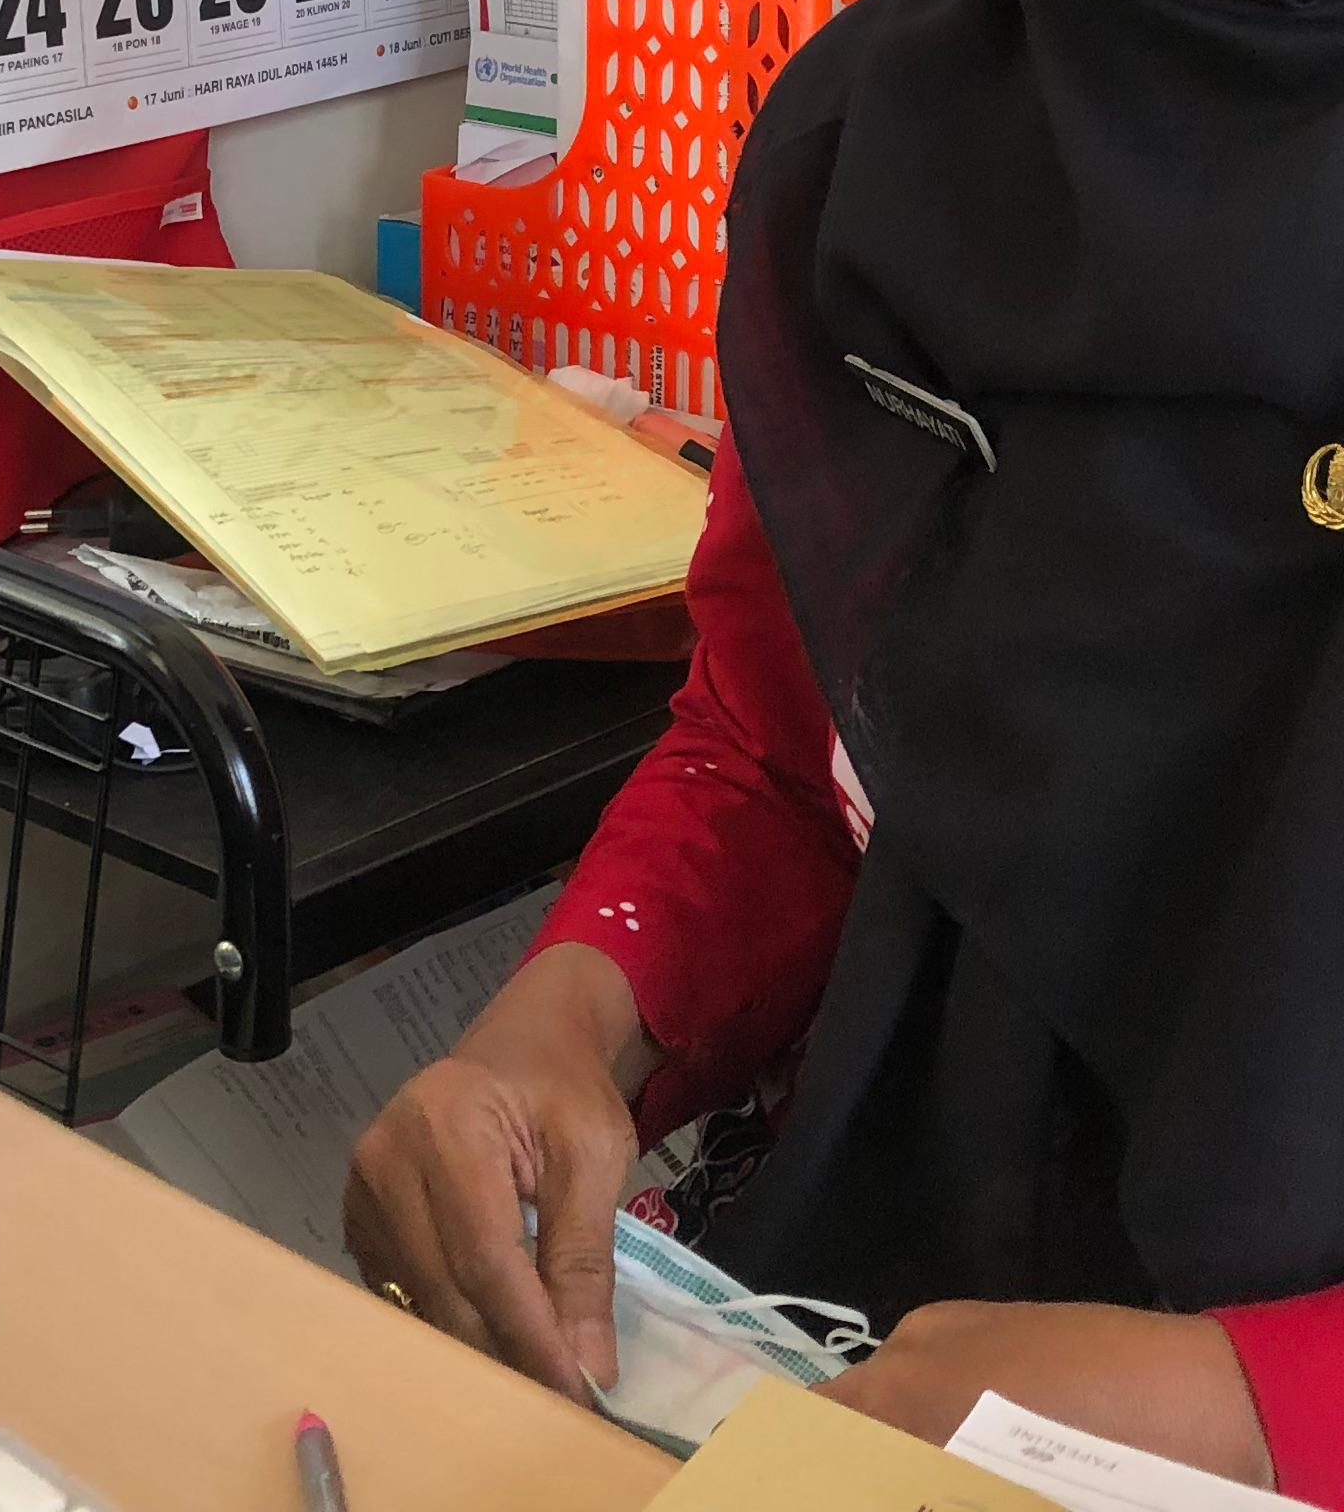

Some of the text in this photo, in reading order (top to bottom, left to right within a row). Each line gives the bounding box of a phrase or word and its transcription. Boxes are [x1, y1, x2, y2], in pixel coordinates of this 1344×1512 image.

[388, 42, 400, 55] 18
[401, 37, 422, 53] Juni
[429, 31, 452, 47] CUTI
[144, 53, 349, 107] 17 Juni HARI RAYA IDUL ADHA 1445 H
[19, 106, 94, 134] PANCASILA
